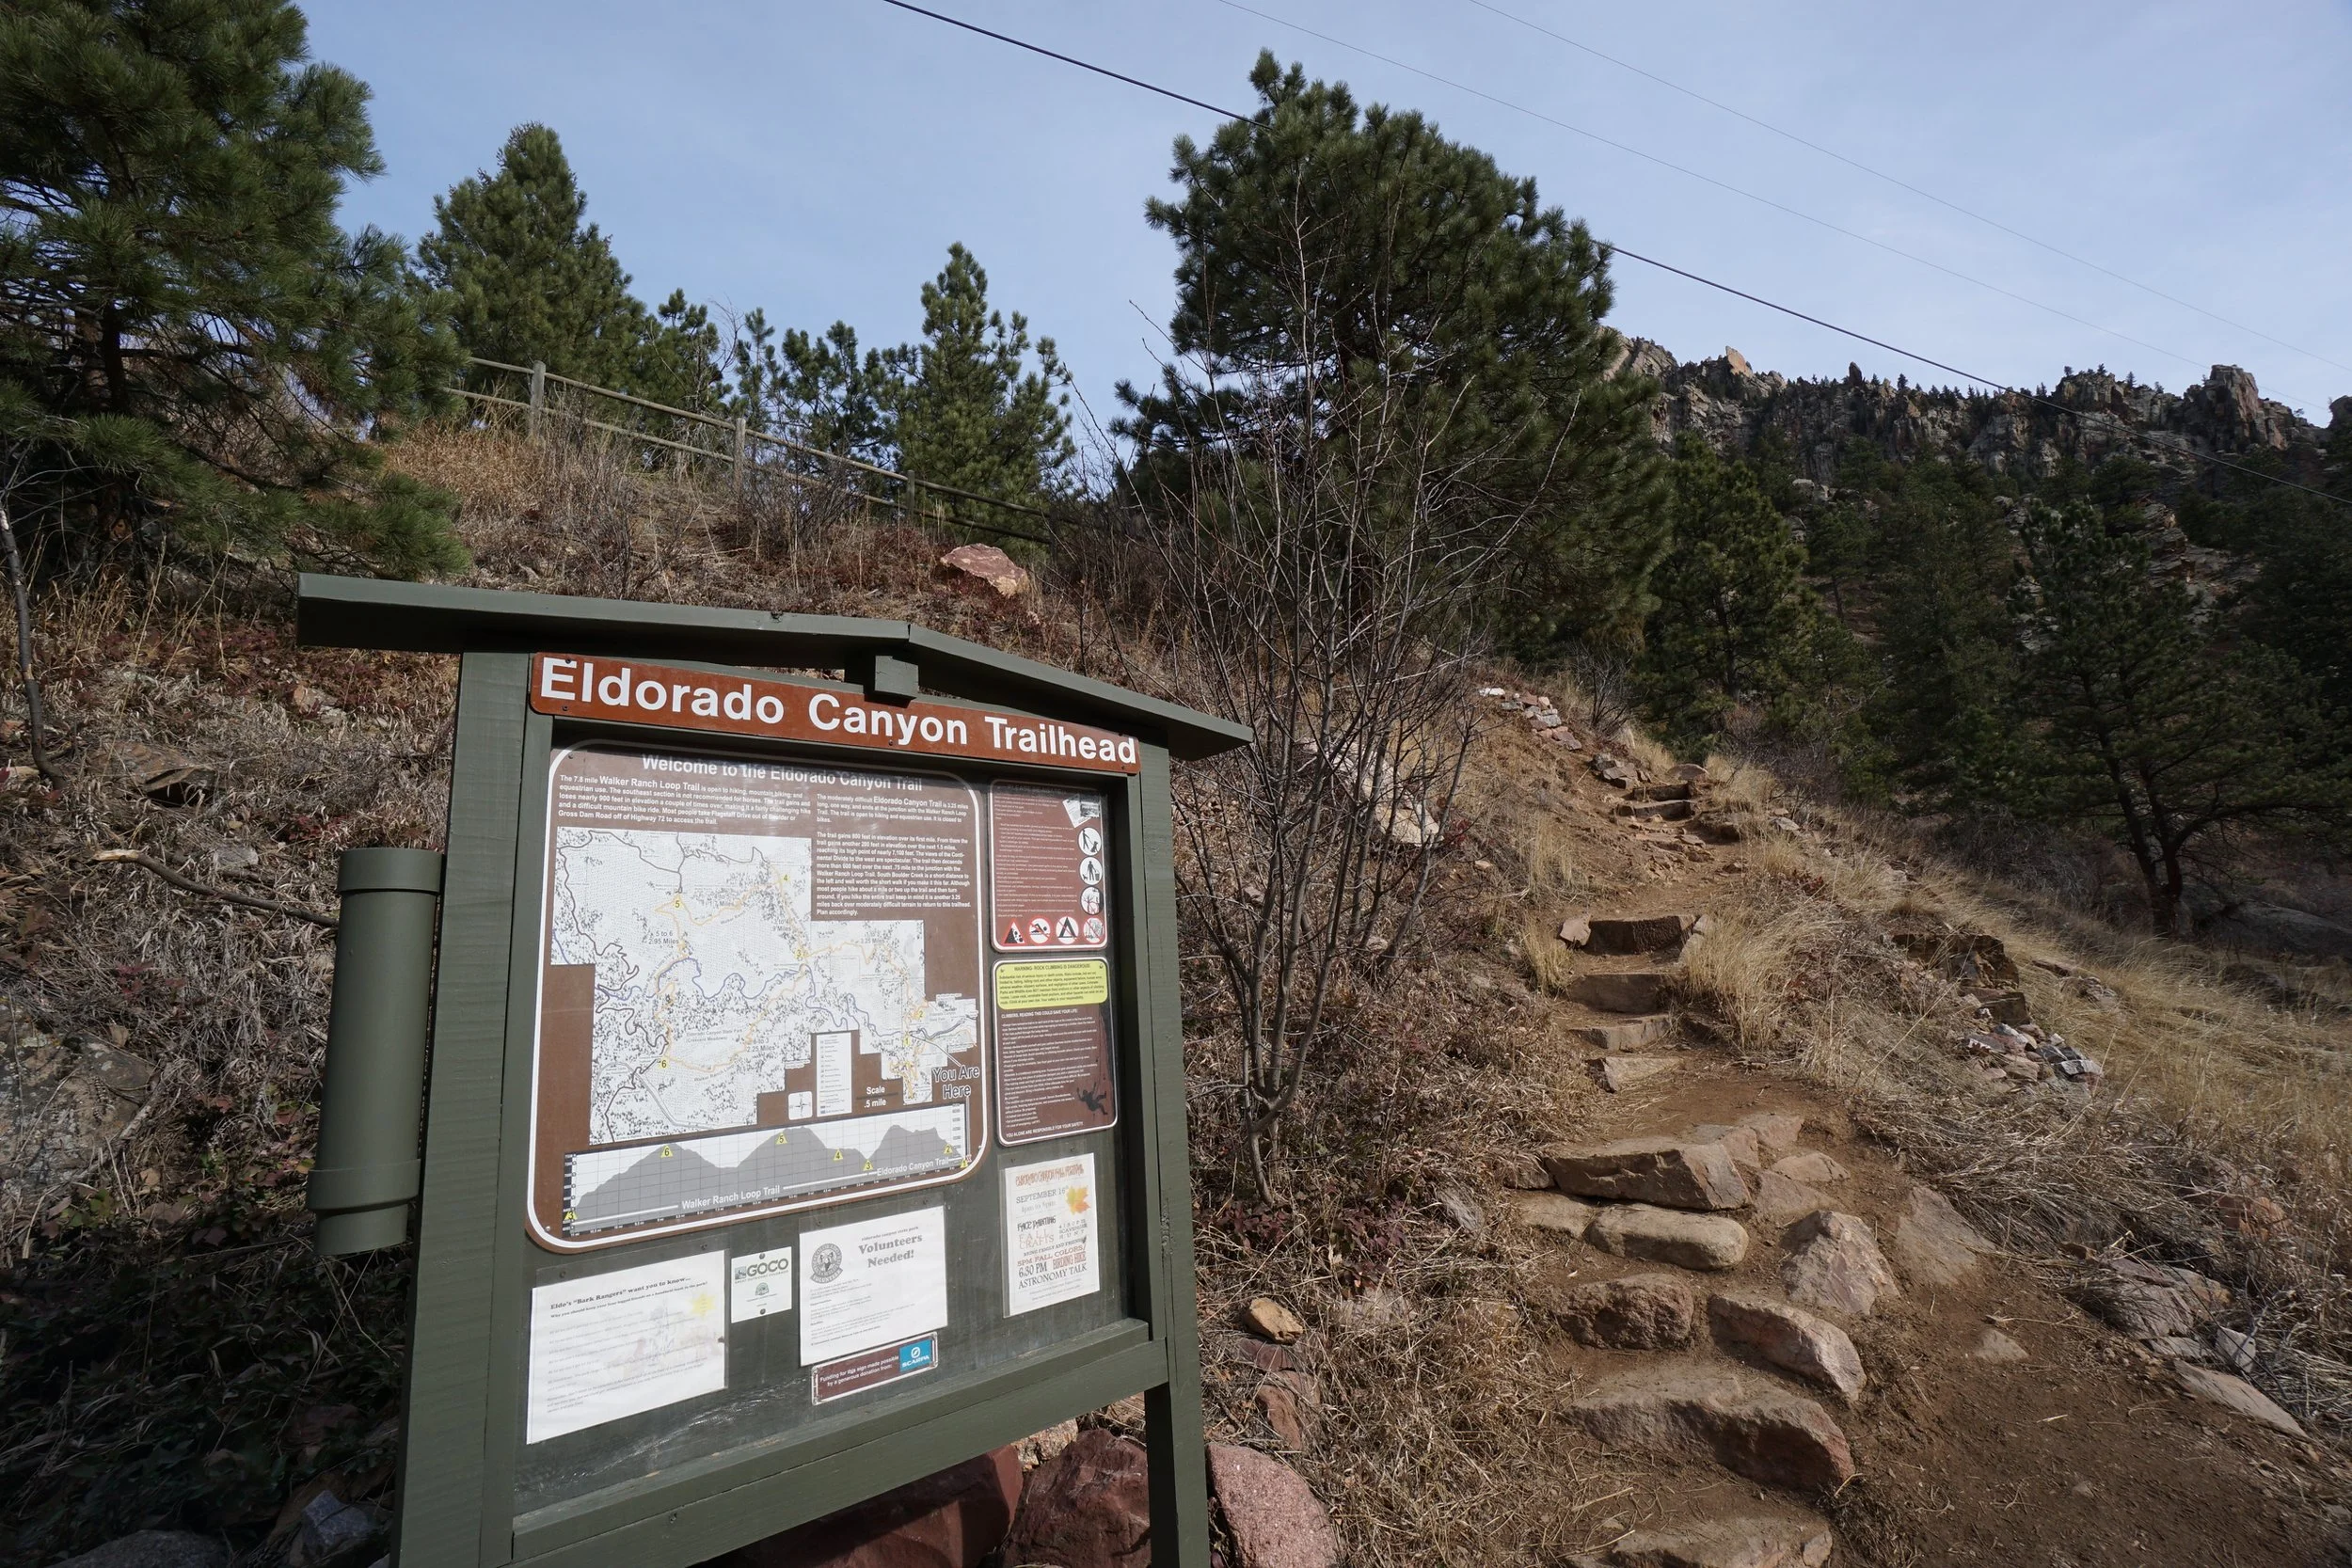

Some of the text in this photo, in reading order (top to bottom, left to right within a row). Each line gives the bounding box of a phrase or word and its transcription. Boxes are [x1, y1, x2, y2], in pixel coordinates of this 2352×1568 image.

[540, 657, 1136, 764] Eldorado Canyon Trailhead
[642, 755, 922, 791] Welcome to the Eldorado Canyon Trail
[599, 775, 629, 786] Walker
[630, 778, 658, 788] Ranch
[660, 780, 681, 792] Loop
[682, 782, 700, 791] Trail
[786, 799, 800, 807] gains
[828, 795, 853, 803] moderately
[873, 796, 903, 805] Eldorado
[903, 798, 927, 808] Canyon
[929, 799, 942, 808] Trail
[631, 814, 656, 823] Highway
[678, 808, 697, 816] people
[829, 909, 858, 917] accordingly.
[661, 1060, 667, 1069] 6
[932, 1065, 979, 1083] You Are
[866, 1085, 885, 1095] Scale
[943, 1084, 971, 1100] Here
[874, 1099, 887, 1107] mile
[780, 1134, 784, 1143] 5
[664, 1148, 670, 1156] 6
[877, 1157, 949, 1176] Eldorado Canyon Trail
[681, 1185, 781, 1210] Walker Ranch Loop Trail
[1016, 1189, 1057, 1204] SEPTEMBER
[858, 1234, 923, 1255] Volunteers
[1020, 1234, 1054, 1249] CRAFTS
[867, 1249, 914, 1268] Needed!
[1017, 1259, 1032, 1267] 5PM
[1035, 1254, 1053, 1262] FALL
[747, 1259, 788, 1276] GOCO
[1036, 1261, 1047, 1274] PM
[1018, 1268, 1067, 1290] ASTRONOMY
[1069, 1263, 1087, 1275] TALK
[550, 1301, 572, 1310] Eldo's
[645, 1283, 659, 1291] you
[901, 1354, 930, 1368] SCARPA
[819, 1372, 839, 1383] Funding
[857, 1365, 867, 1374] sign
